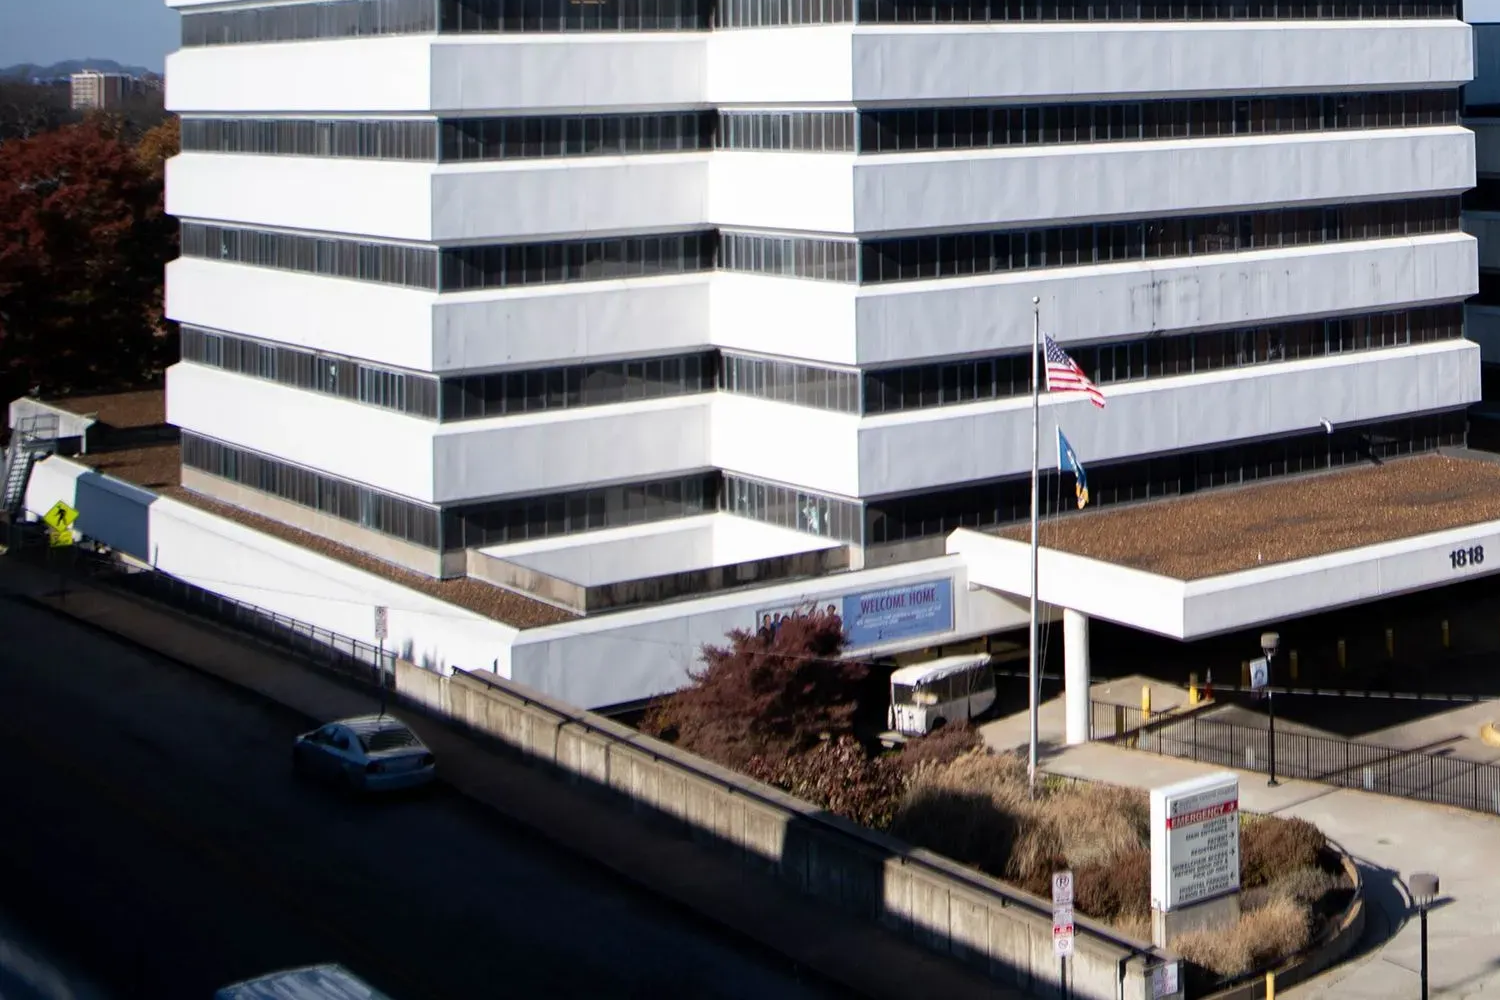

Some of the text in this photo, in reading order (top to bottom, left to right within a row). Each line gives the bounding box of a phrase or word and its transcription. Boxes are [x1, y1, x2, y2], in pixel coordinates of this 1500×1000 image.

[1449, 545, 1485, 569] 1818
[861, 593, 905, 615] WELCOME
[1171, 805, 1225, 829] EMERGENCY
